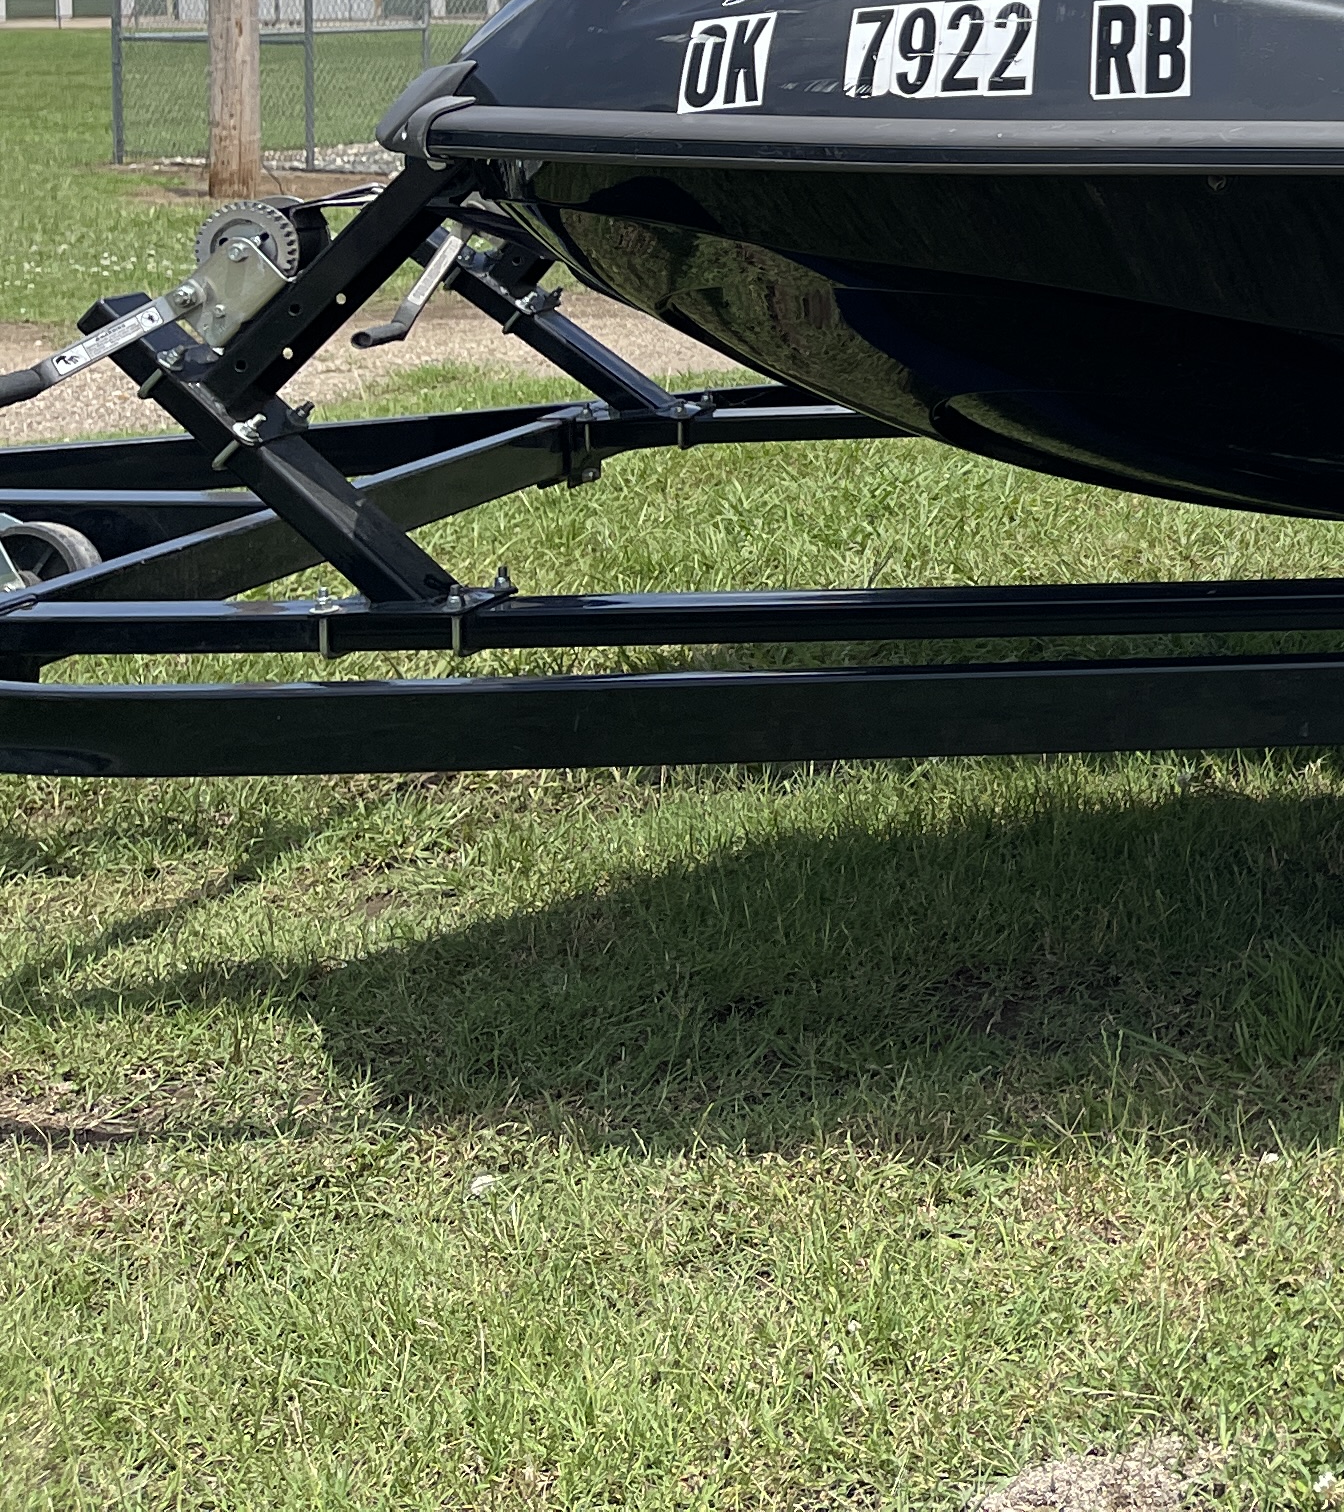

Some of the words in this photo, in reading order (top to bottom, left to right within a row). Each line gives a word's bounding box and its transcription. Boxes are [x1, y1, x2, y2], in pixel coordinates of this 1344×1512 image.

[684, 16, 771, 108] OK
[855, 1, 1033, 97] 7922
[1095, 3, 1186, 95] RB
